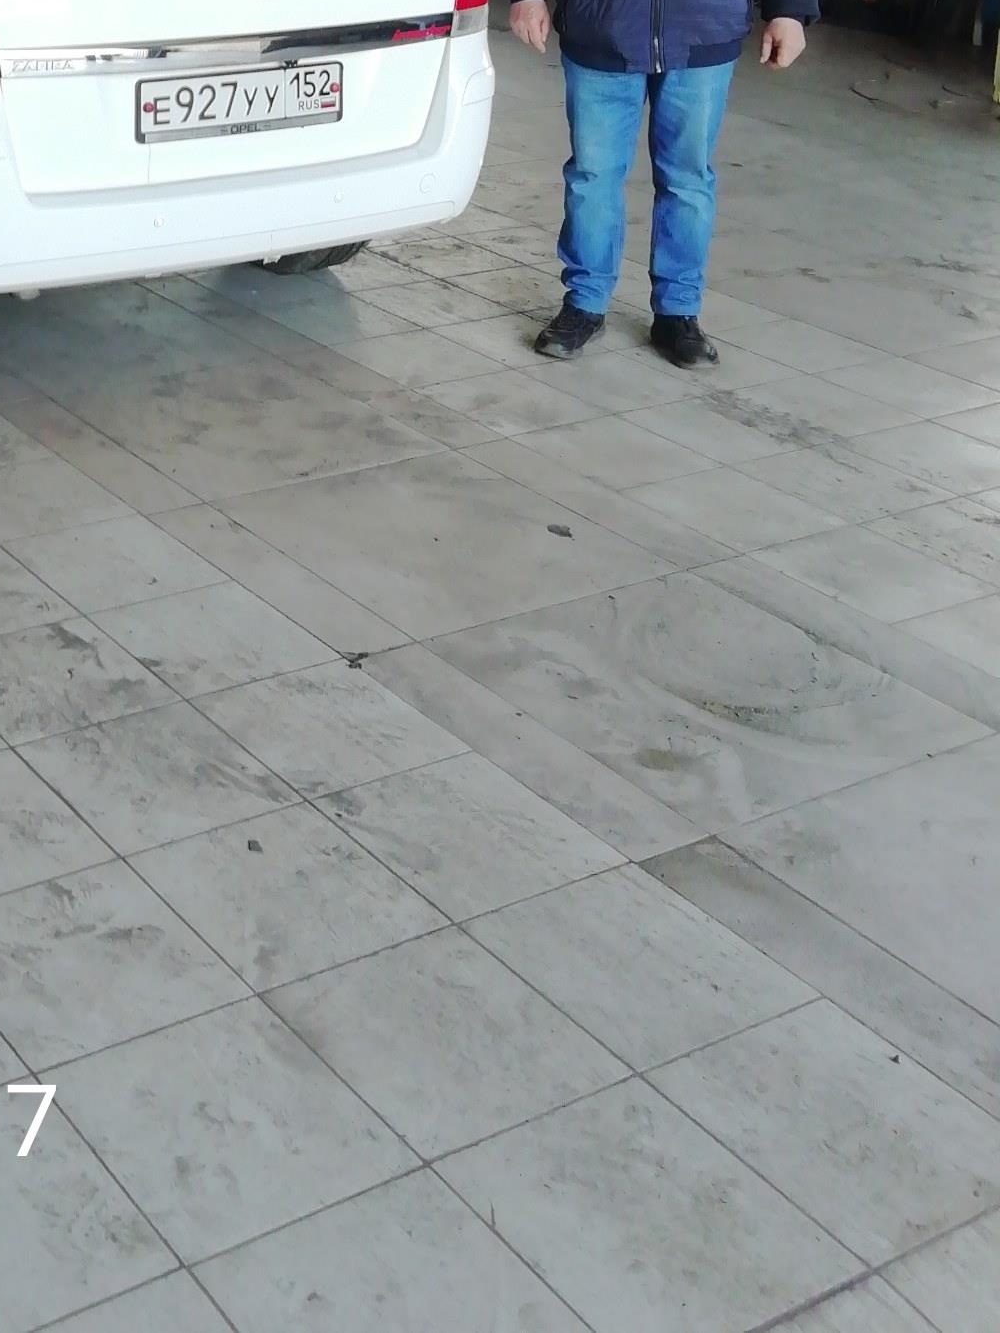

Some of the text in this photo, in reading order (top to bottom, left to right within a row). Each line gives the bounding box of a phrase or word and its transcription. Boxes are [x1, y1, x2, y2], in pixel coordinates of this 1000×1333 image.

[289, 69, 331, 99] 152
[298, 98, 320, 111] RUS
[230, 123, 261, 135] OPEL
